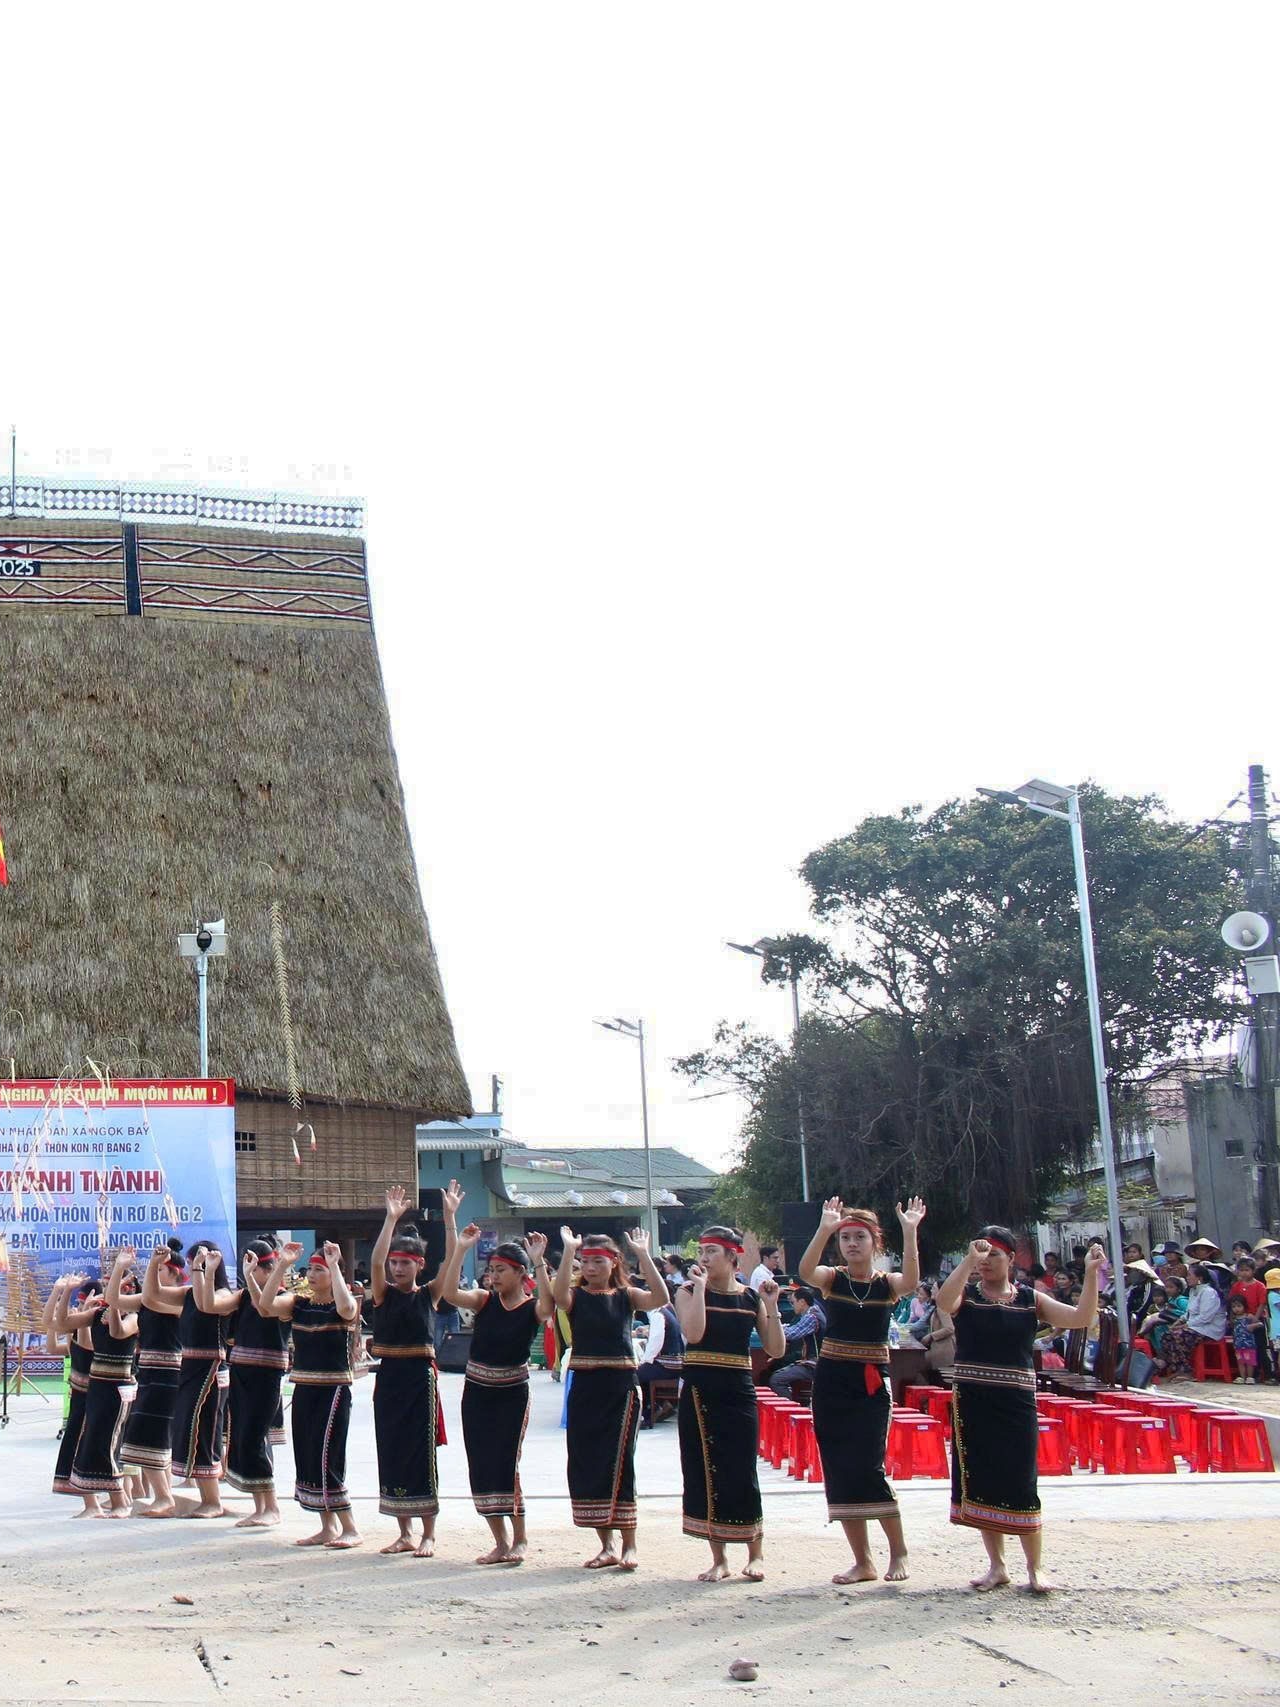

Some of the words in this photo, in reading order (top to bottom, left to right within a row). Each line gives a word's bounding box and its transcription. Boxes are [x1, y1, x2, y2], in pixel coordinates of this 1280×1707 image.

[85, 1088, 119, 1101] NAM
[124, 1085, 168, 1101] MUÔN
[172, 1085, 207, 1101] NĂM
[212, 1087, 218, 1101] !
[127, 1126, 150, 1136] BAY
[71, 1142, 89, 1153] KON
[134, 1143, 140, 1153] 2
[80, 1166, 162, 1194] THÀNH
[54, 1203, 89, 1222] THÔN
[128, 1205, 147, 1222] RƠ
[194, 1206, 202, 1222] 2
